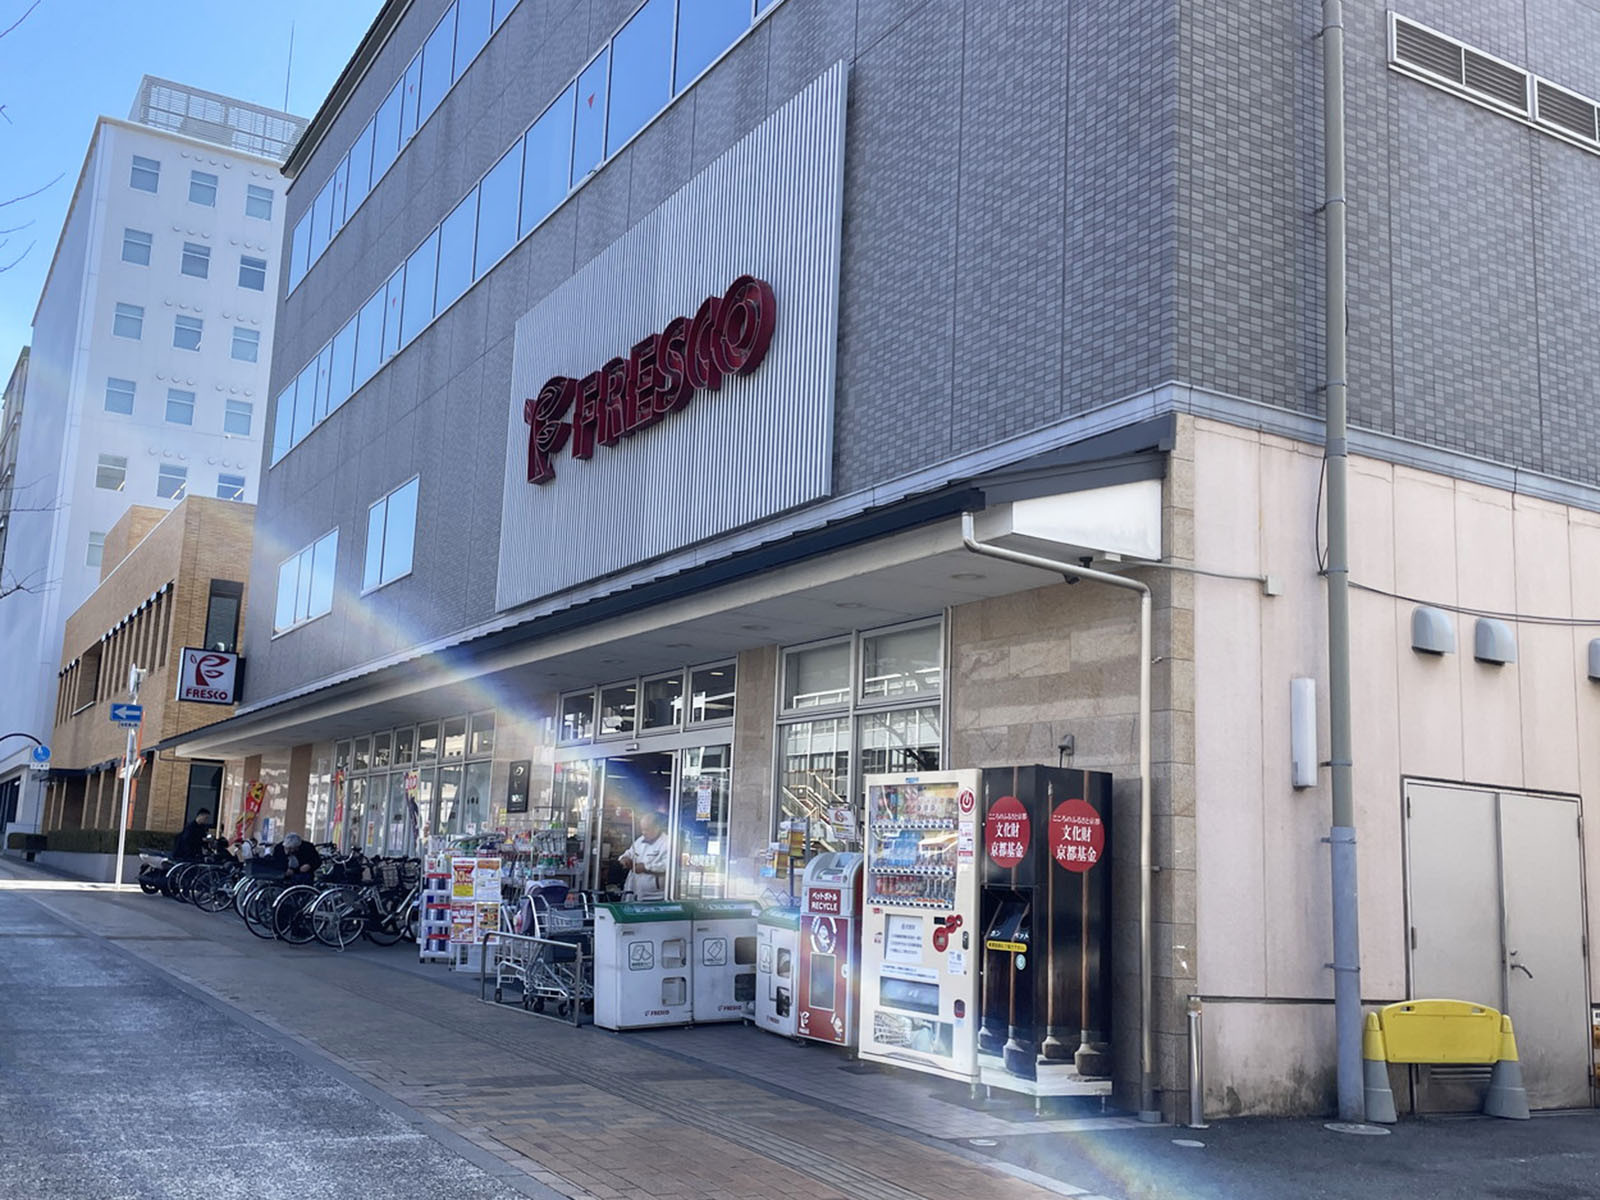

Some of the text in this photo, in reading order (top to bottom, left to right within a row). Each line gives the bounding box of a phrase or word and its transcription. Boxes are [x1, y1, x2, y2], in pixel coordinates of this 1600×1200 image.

[571, 274, 777, 461] FRESCO
[186, 688, 228, 700] FRESCO
[995, 822, 1020, 838] 文化財
[1062, 825, 1092, 842] 文化財
[991, 842, 1024, 858] 京都基金
[1056, 845, 1097, 863] 京都基金
[811, 901, 838, 912] RECYCLE
